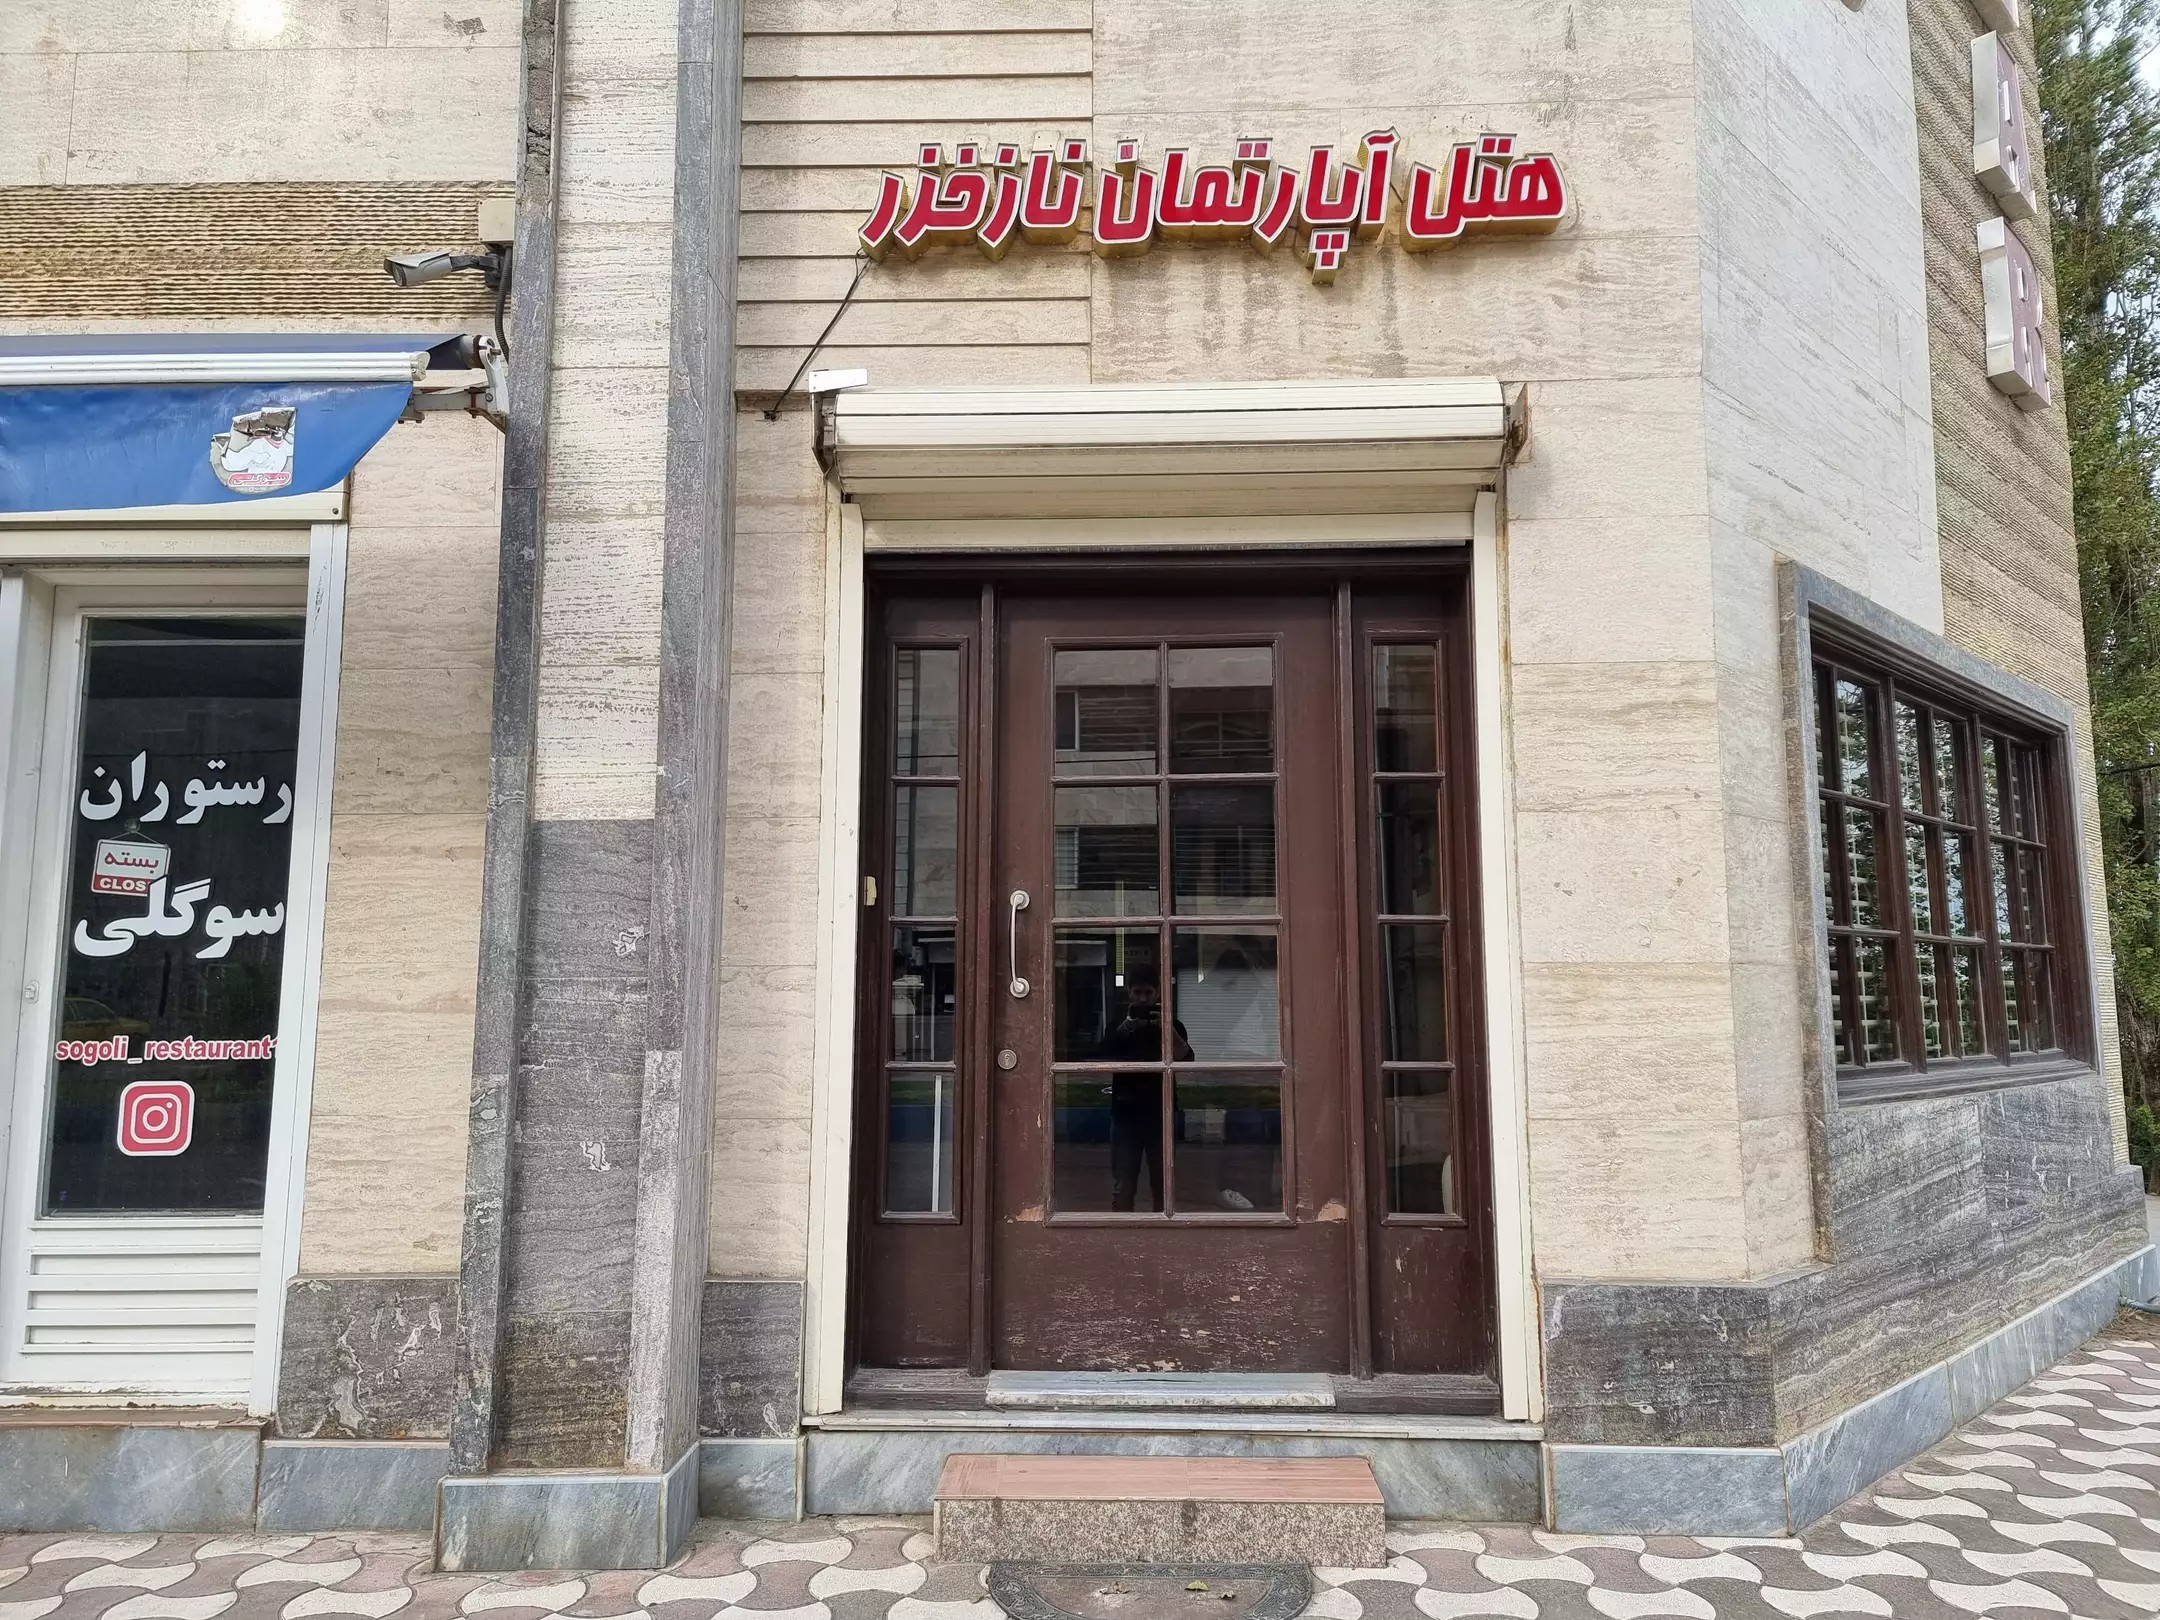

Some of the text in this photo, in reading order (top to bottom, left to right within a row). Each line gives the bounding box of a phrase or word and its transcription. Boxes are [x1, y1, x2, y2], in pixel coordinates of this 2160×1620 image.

[1095, 126, 1401, 270] آپارتمان
[1407, 132, 1570, 240] هتل
[80, 750, 293, 825] رستوران
[99, 876, 150, 893] CLOS
[104, 851, 159, 875] بسته
[74, 874, 286, 960] سوگلی
